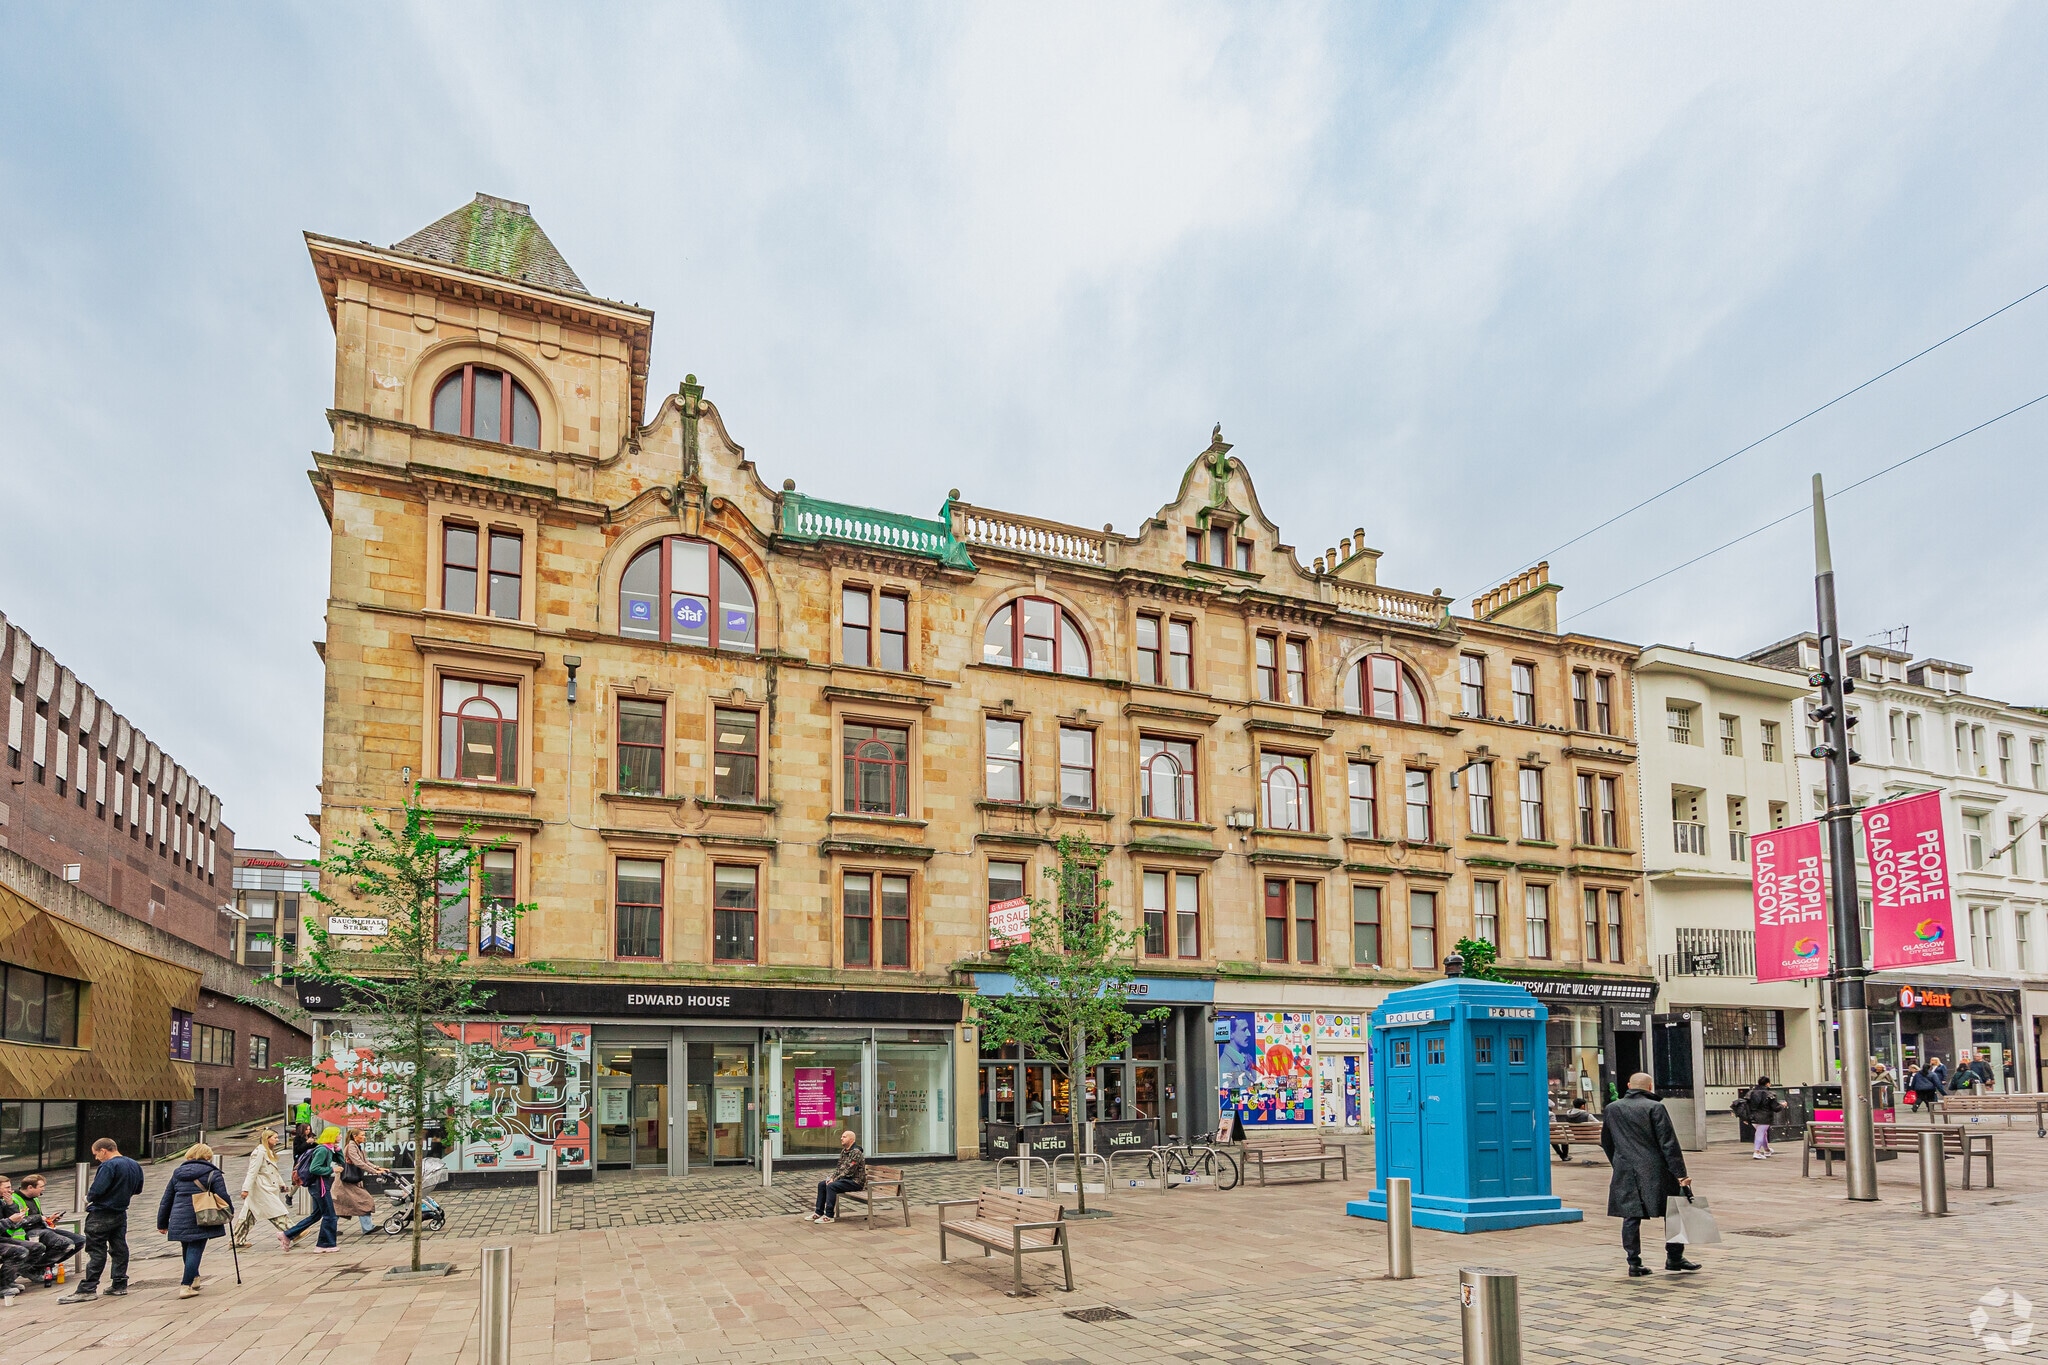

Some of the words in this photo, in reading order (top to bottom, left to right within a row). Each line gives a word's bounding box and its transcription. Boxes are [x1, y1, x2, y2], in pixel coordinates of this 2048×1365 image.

[677, 605, 702, 622] staf
[242, 858, 288, 869] Hampton
[1868, 813, 1899, 907] GLASGOW
[1916, 829, 1945, 902] PEOPLE
[1755, 839, 1779, 926] GLASGOW
[1896, 850, 1922, 906] MAKE
[1798, 856, 1823, 923] PEOPLE
[1777, 874, 1801, 926] MAKE
[989, 914, 1004, 926] FOR
[1006, 909, 1028, 923] SALE
[1008, 923, 1018, 932] SQ
[1902, 940, 1945, 952] GLASGOW
[1781, 957, 1820, 967] GLASGOW
[1543, 982, 1555, 993] AT
[1555, 983, 1572, 994] THE
[1572, 983, 1601, 996] WILLOW
[304, 996, 321, 1004] 199
[627, 994, 683, 1006] EDWARD
[687, 995, 731, 1007] HOUSE
[1921, 990, 1952, 1008] Mart
[1389, 1011, 1431, 1023] POLICE
[361, 1057, 416, 1076] Neve
[994, 1140, 1009, 1149] NERO
[1033, 1140, 1066, 1150] NERO
[1110, 1136, 1141, 1145] NERO
